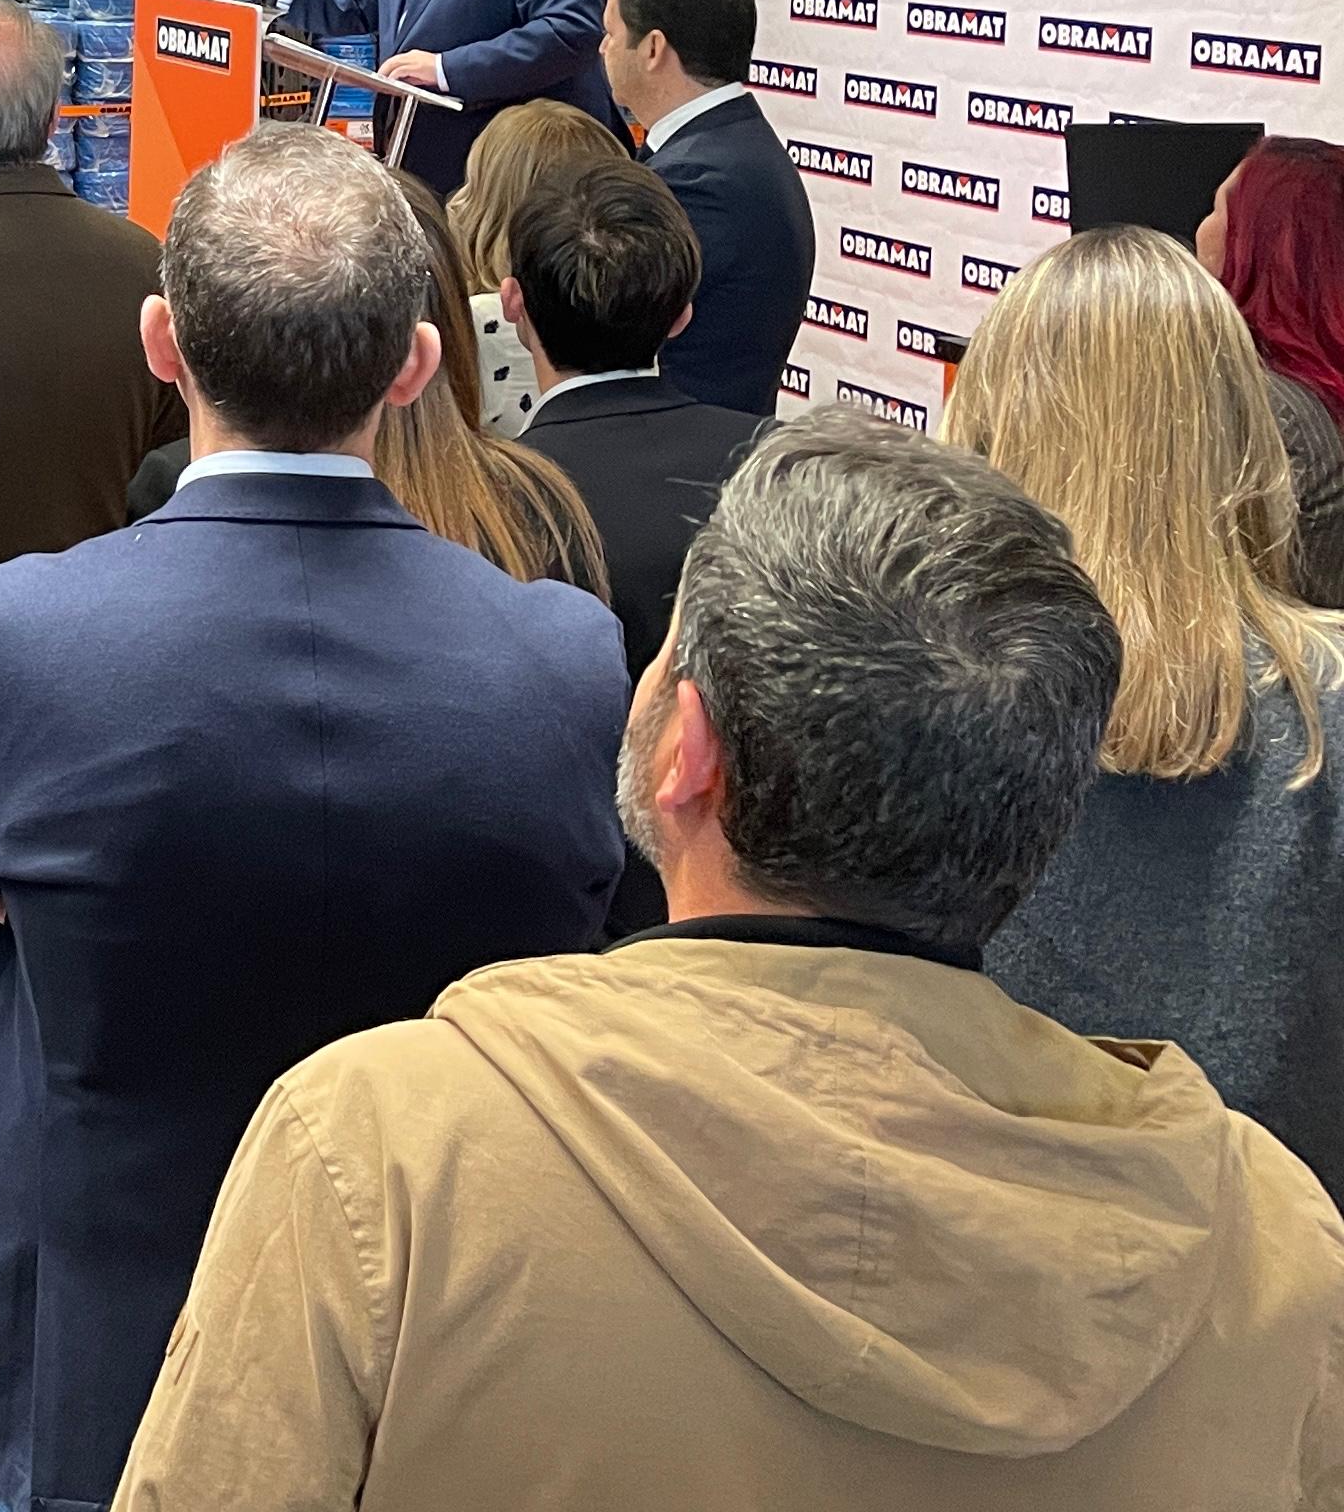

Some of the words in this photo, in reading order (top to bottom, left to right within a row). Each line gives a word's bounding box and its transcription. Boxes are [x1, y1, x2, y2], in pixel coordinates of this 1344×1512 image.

[910, 9, 1004, 39] OBRAMAT
[1041, 23, 1149, 55] OBRAMAT
[158, 25, 229, 64] OBRAMAT
[1194, 40, 1319, 76] OBRAMAT
[846, 79, 935, 109] OBRAMAT
[971, 98, 1071, 130] OBRAMAT
[789, 146, 870, 179] OBRAMAT
[904, 169, 998, 203] OBRAMAT
[842, 234, 930, 273] OBRAMAT
